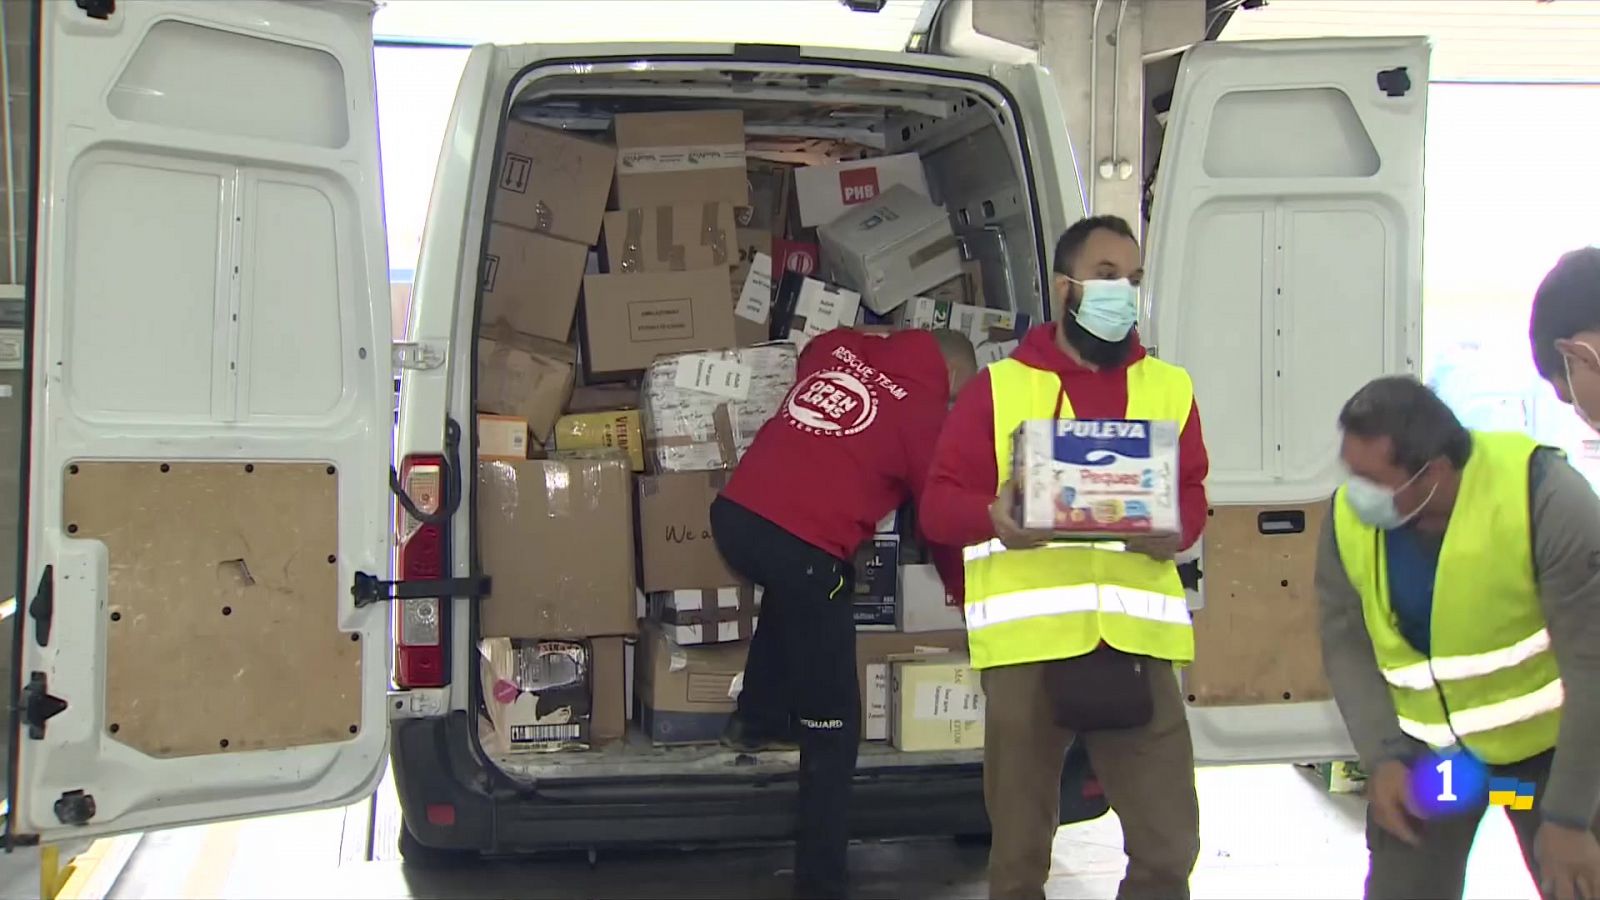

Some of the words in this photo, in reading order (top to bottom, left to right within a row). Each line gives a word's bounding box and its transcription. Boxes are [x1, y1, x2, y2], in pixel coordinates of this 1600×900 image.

[844, 184, 874, 200] PHB
[831, 346, 876, 379] RESCUE
[875, 372, 909, 400] TEAM
[798, 390, 846, 419] ARMS
[809, 380, 858, 412] OPEN
[1056, 420, 1147, 439] PULEVA
[1141, 468, 1154, 488] 2
[665, 525, 696, 543] We
